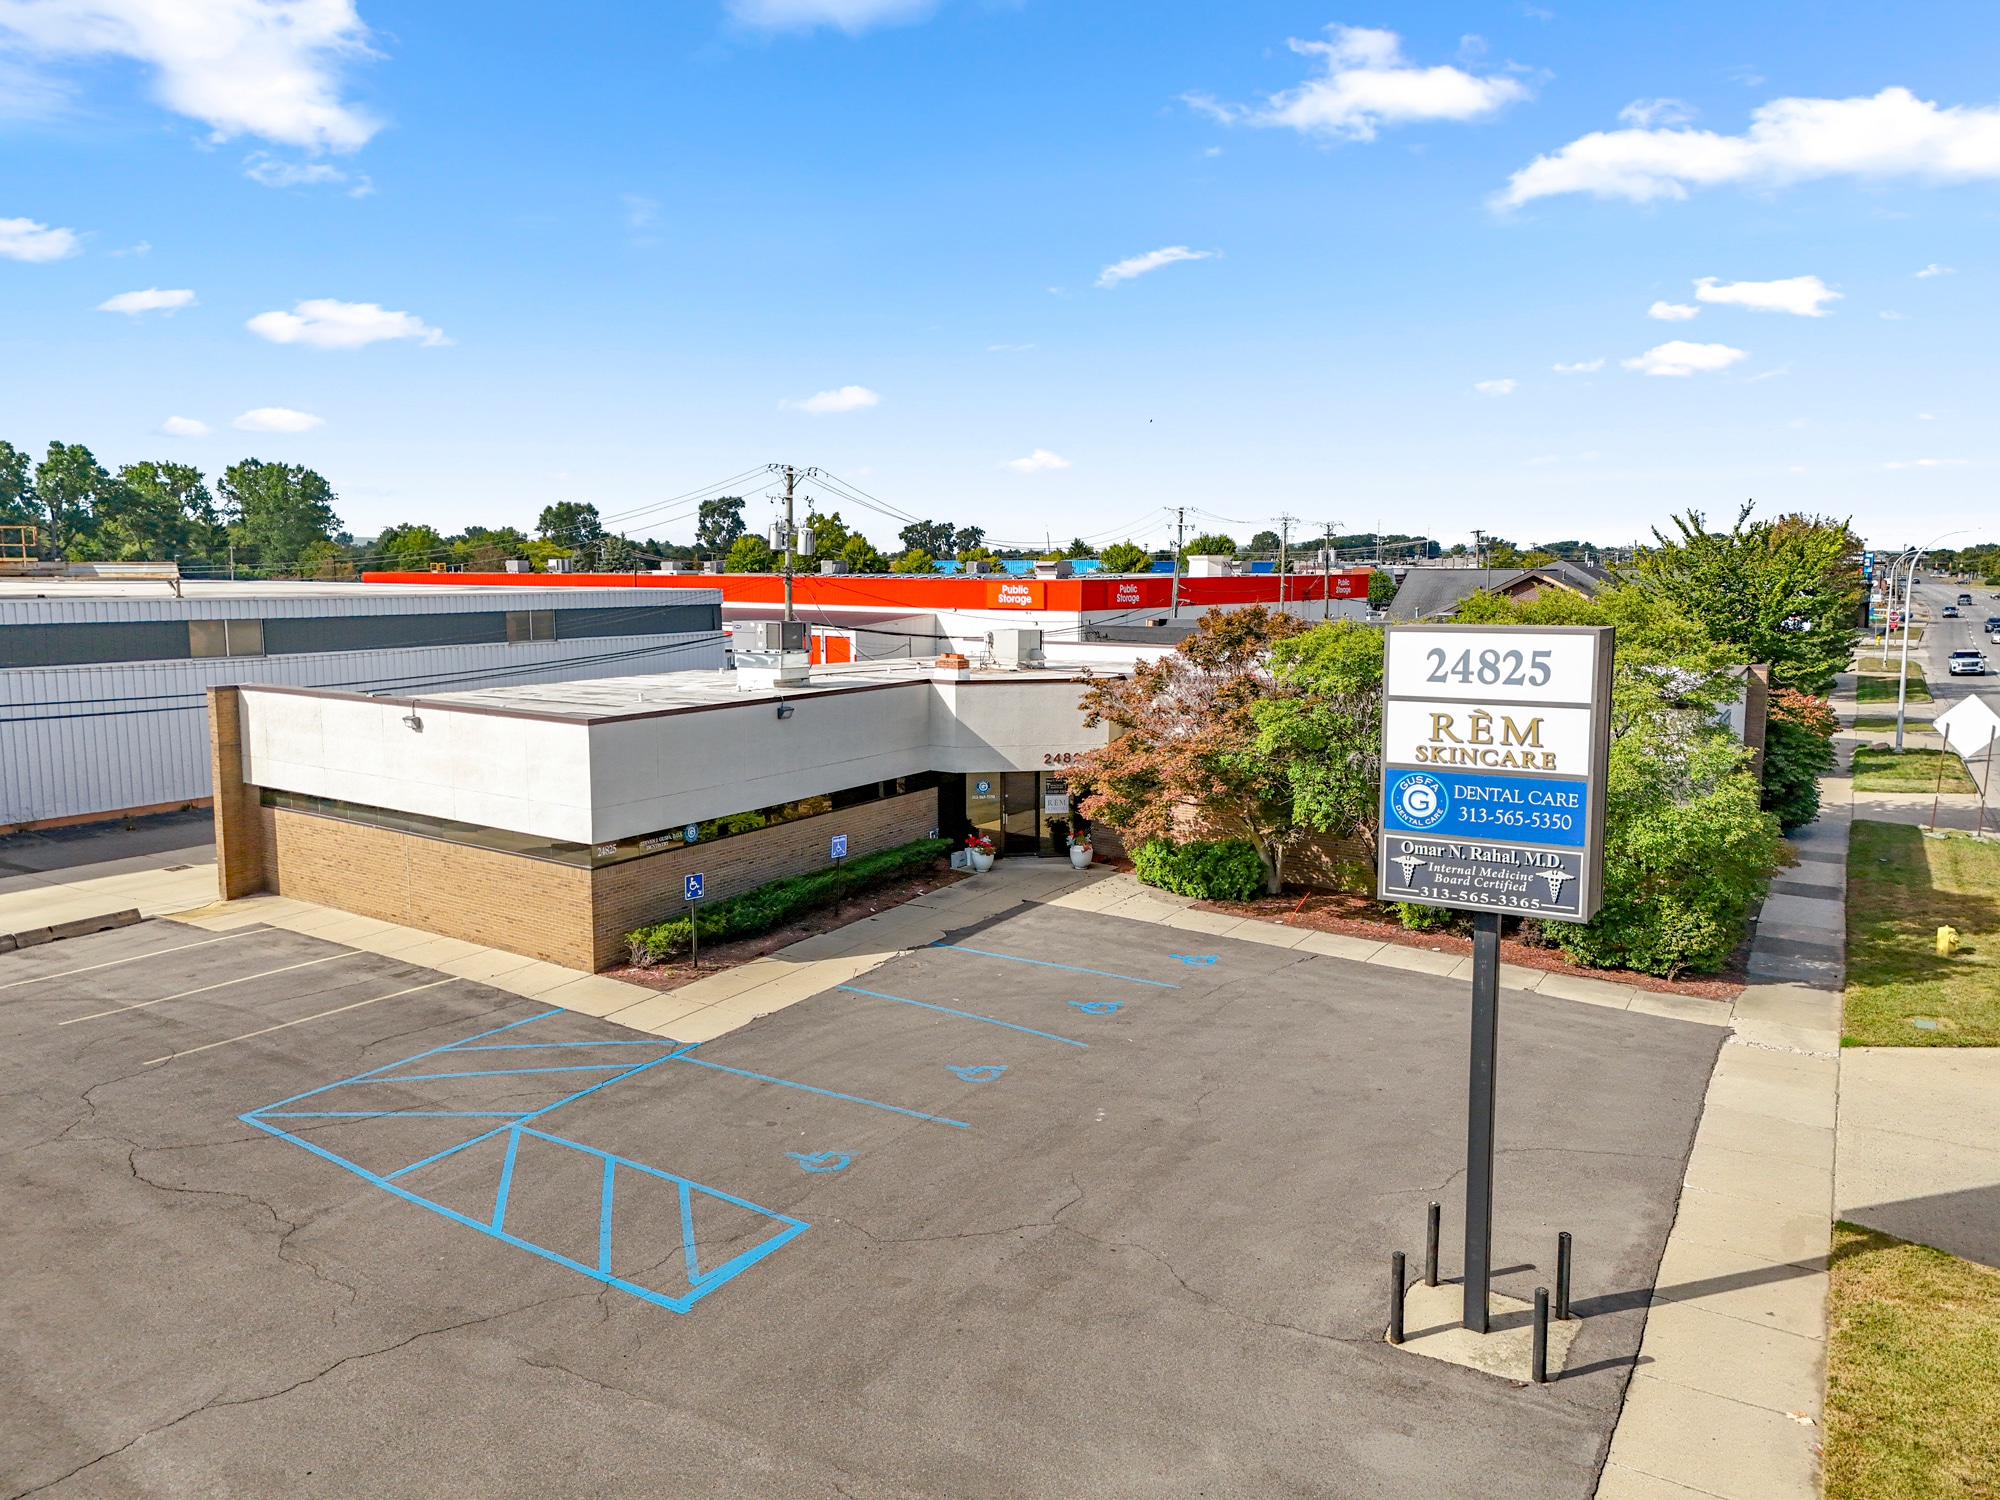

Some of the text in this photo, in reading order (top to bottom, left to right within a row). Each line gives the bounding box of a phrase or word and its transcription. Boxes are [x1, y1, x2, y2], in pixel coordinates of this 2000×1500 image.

[1002, 584, 1029, 594] Public
[1116, 593, 1140, 604] Storage
[1119, 584, 1137, 593] Public
[998, 593, 1032, 606] Storage
[1426, 647, 1552, 687] 24825
[1428, 708, 1544, 748] RÈM
[1415, 745, 1557, 770] SKINCARE
[1400, 776, 1439, 792] GUSFA
[1408, 790, 1429, 811] G
[1454, 785, 1579, 808] DENTAL CARE
[1396, 805, 1444, 826] DENTAL CARE
[1458, 806, 1572, 830] 313-565-5350
[1401, 840, 1565, 869] Omar N. Rahal, M.D.
[1428, 861, 1534, 882] Internal Medicine
[1434, 873, 1527, 893] Board Certified
[1420, 886, 1541, 909] 313-565-3365
